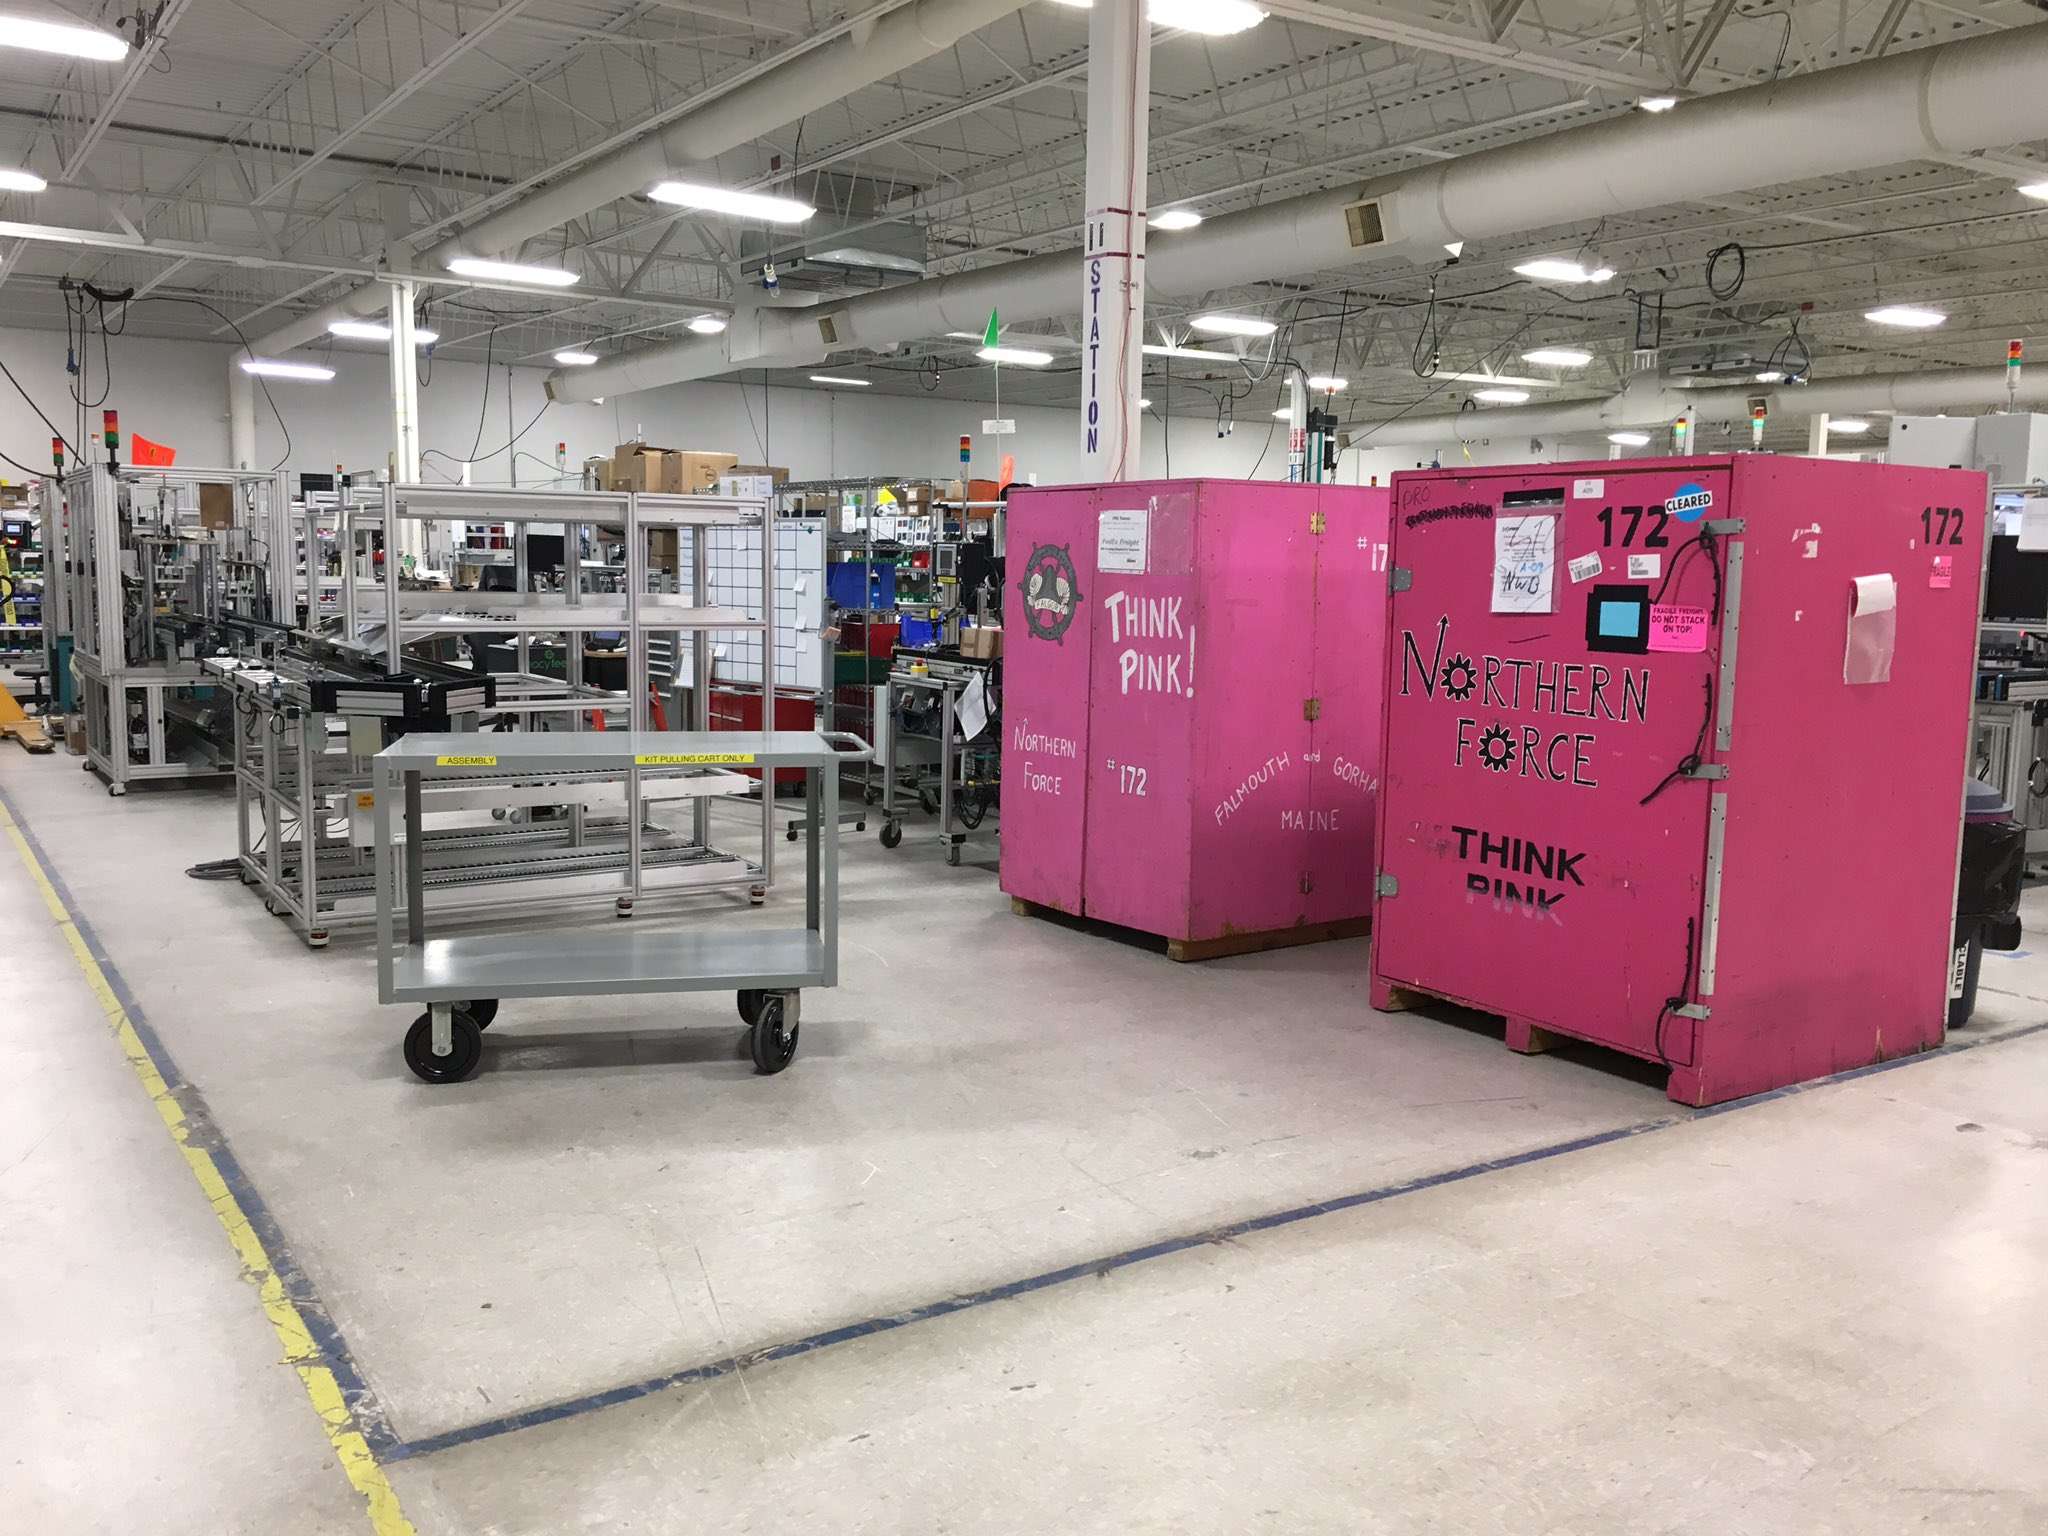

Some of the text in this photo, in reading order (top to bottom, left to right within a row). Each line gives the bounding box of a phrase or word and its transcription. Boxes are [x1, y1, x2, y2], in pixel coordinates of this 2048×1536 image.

[1087, 260, 1101, 453] STATION
[1665, 493, 1712, 513] CLEARED
[1597, 505, 1669, 548] 172
[1921, 507, 1964, 545] 172
[1357, 536, 1389, 572] #17
[1104, 590, 1184, 643] THINK
[1663, 625, 1674, 633] ON
[1681, 616, 1705, 624] STACK
[1119, 625, 1195, 698] PINK!
[1399, 614, 1651, 724] NORTHERN
[645, 754, 746, 764] KIT PULLING CART ONLY
[1013, 717, 1077, 759] NORTHERN
[1455, 717, 1598, 788] FORCE
[447, 756, 494, 766] ASSEMBLY
[1024, 761, 1062, 796] FORCE
[1214, 751, 1378, 827] FALMOUTH and GORHA
[1280, 808, 1340, 832] MAINE
[1451, 825, 1587, 887] THINK
[1466, 873, 1566, 927] PINK
